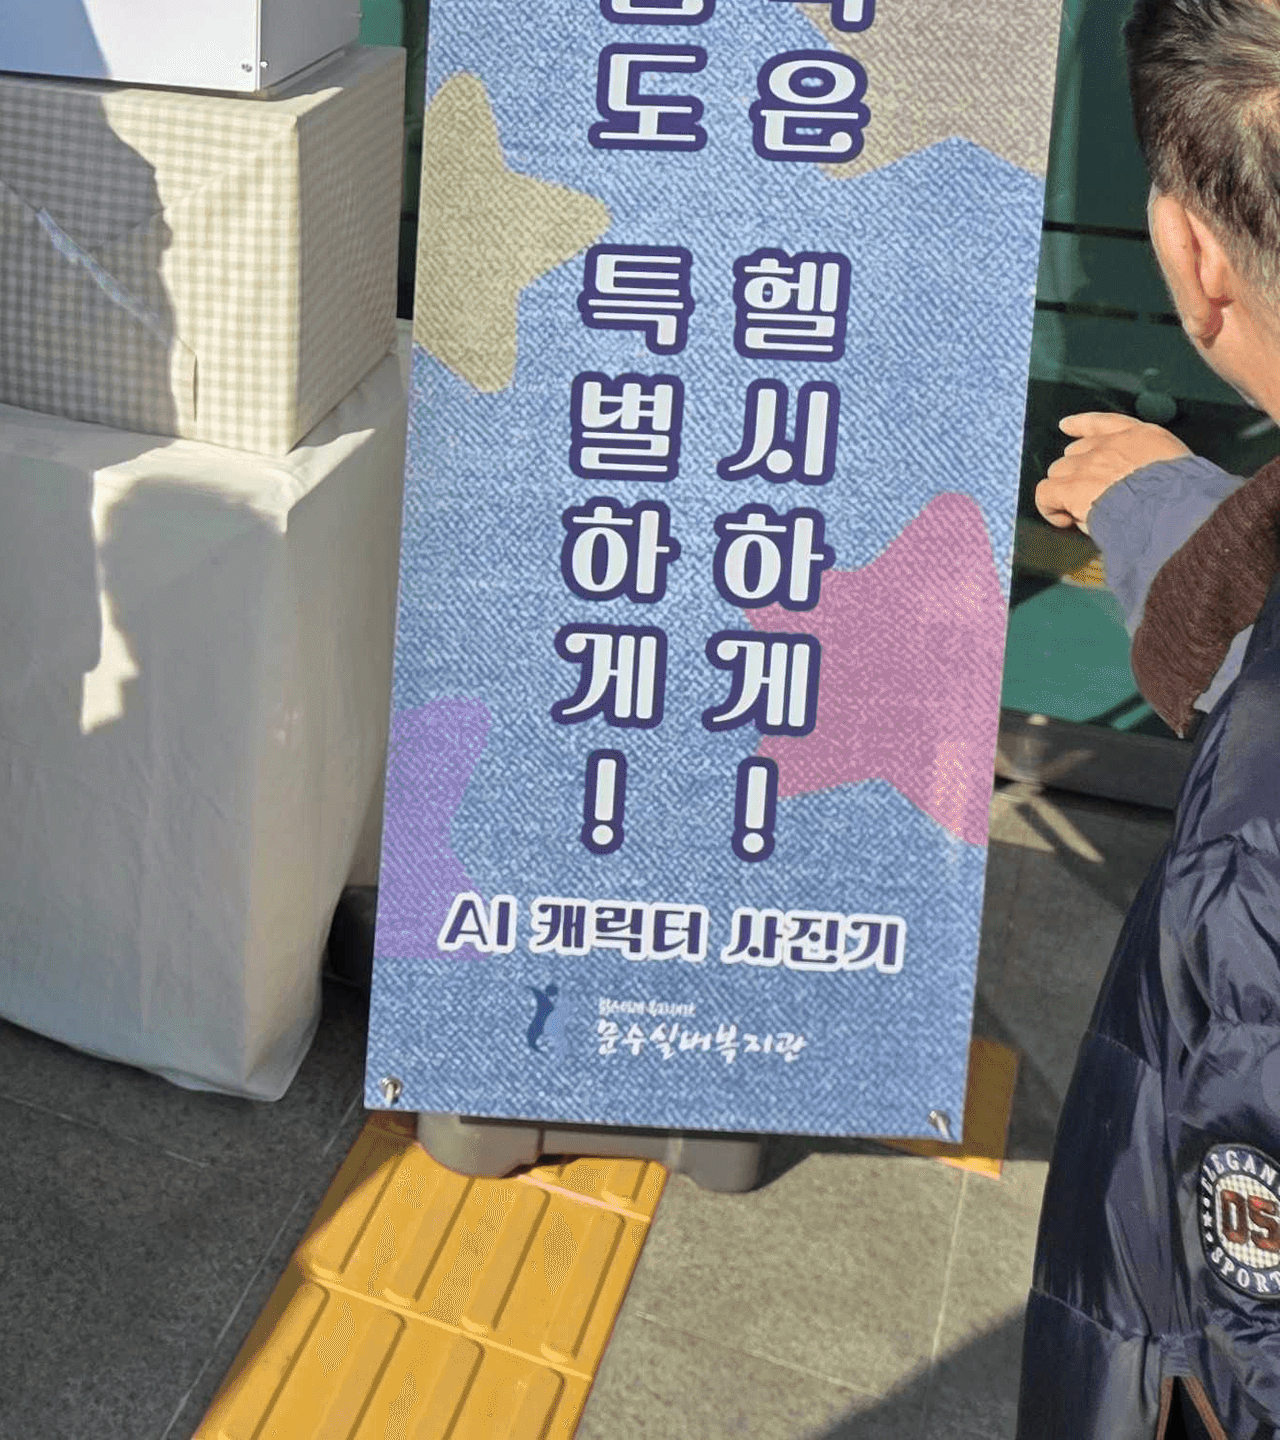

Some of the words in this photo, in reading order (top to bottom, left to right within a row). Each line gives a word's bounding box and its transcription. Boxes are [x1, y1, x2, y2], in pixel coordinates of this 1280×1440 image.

[558, 248, 691, 850] 특별하게!
[707, 251, 847, 859] 헬시하게!
[440, 895, 515, 952] AI
[532, 900, 706, 959] 캐릭터
[723, 909, 904, 971] 사진기
[1201, 1149, 1280, 1197] ELEGAN
